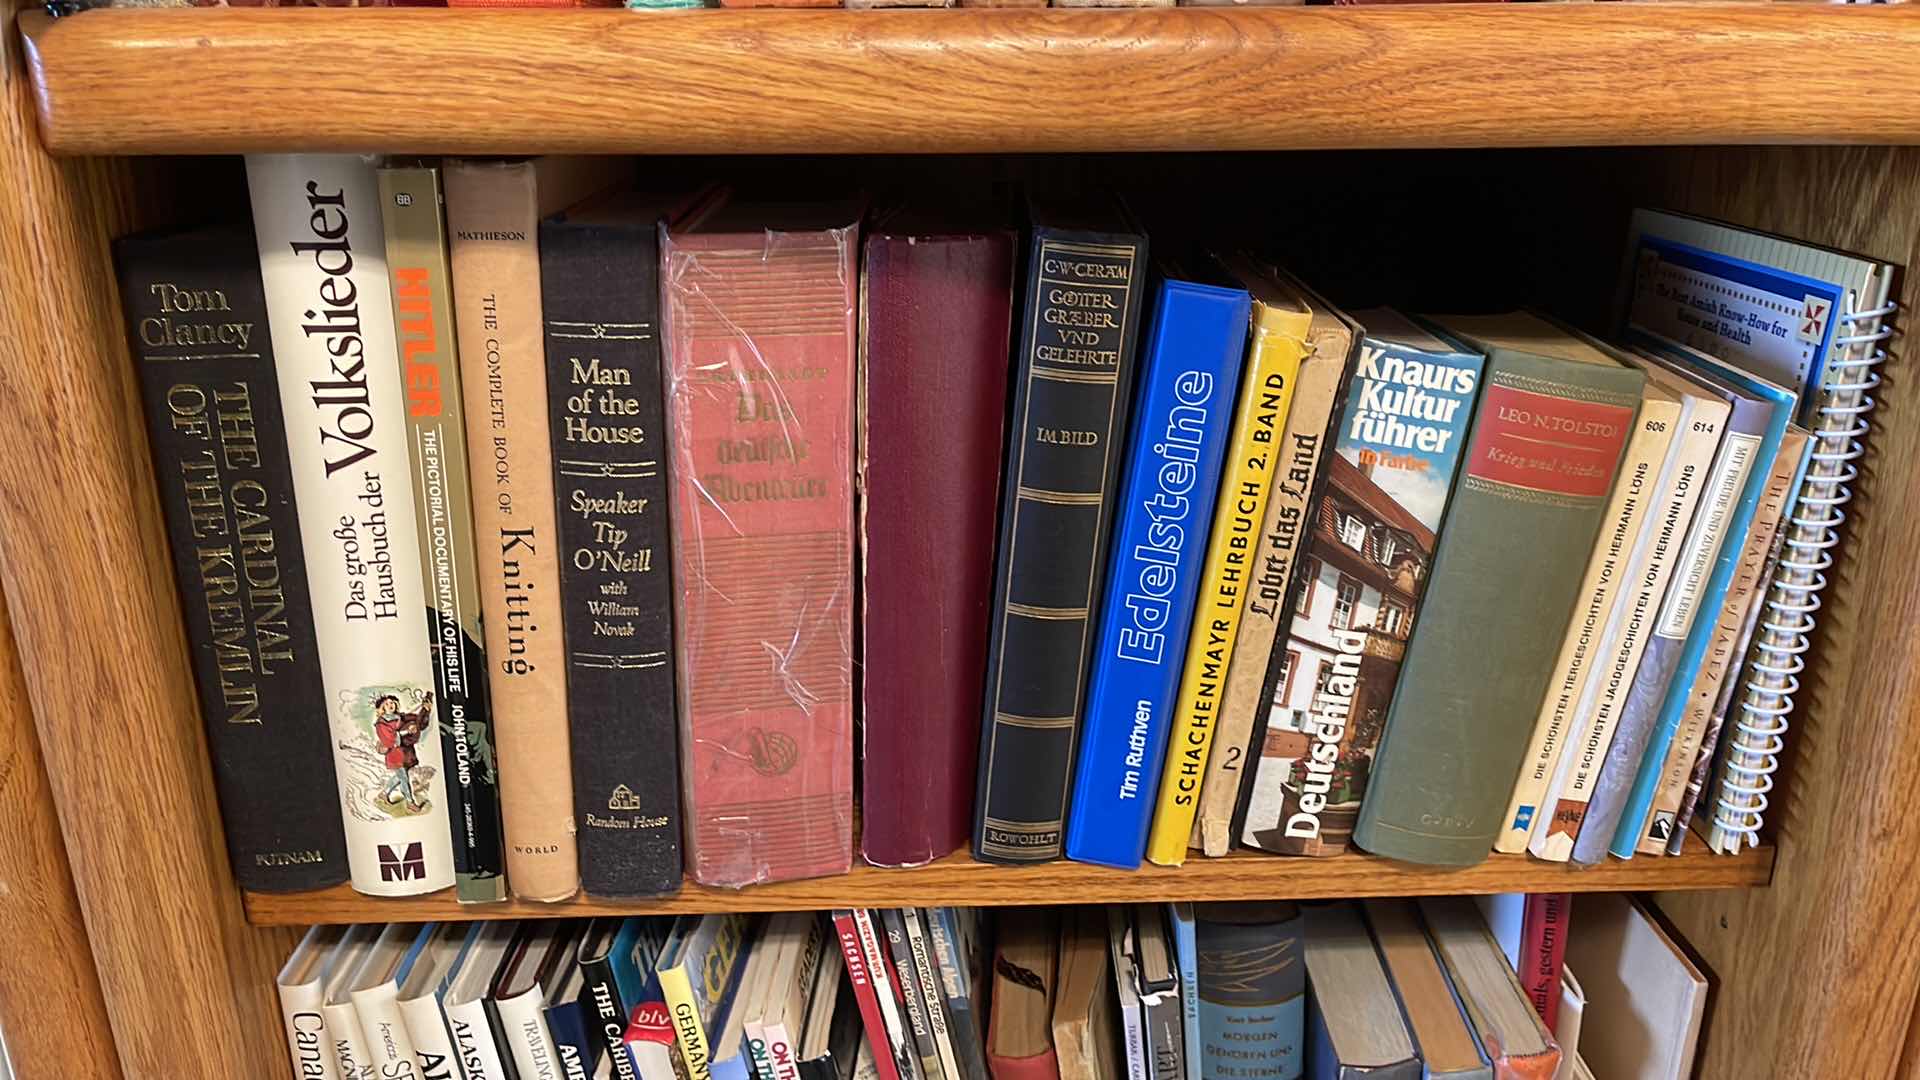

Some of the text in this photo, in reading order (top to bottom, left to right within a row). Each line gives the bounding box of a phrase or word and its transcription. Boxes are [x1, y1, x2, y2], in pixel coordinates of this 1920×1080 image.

[457, 232, 525, 241] MATHIESON
[151, 283, 231, 313] Tom
[140, 316, 253, 349] Clancy
[290, 180, 377, 479] Volkslieder
[1057, 329, 1100, 346] VND
[1718, 303, 1772, 333] Know-How
[1771, 321, 1788, 339] for
[1719, 323, 1752, 345] Health
[395, 267, 443, 418] HITLER
[1036, 345, 1118, 365] GELEHRTE
[570, 358, 631, 385] Man
[1356, 346, 1476, 394] Knaurs
[482, 294, 512, 515] THE COMPLETE BOOK OF
[568, 389, 640, 415] of the
[1358, 379, 1461, 423] Kultur
[1498, 406, 1531, 424] LEO
[1534, 414, 1550, 430] N.
[564, 417, 644, 443] House
[1036, 427, 1098, 446] IM BILD
[1350, 411, 1452, 453] führer
[1693, 421, 1713, 433] 614
[1279, 431, 1319, 502] Land
[1359, 448, 1376, 465] in
[1488, 447, 1525, 468] Krieg
[1529, 456, 1558, 472] und
[570, 489, 648, 518] Speaker
[1117, 370, 1213, 665] Edelsteine
[213, 382, 294, 676] THE CARDINAL
[358, 471, 398, 620] Hausbuch der
[592, 521, 628, 550] Tip
[1268, 506, 1301, 550] das
[1672, 446, 1748, 630] MIT FREUDE UND ZUVERSICHT LEBEN
[167, 384, 263, 727] OF THE KREMLIN
[332, 514, 369, 622] Das große
[424, 430, 461, 692] THE PICTORIAL DOCUMENTARY OF HIS LIFE
[574, 548, 651, 572] O'Neill
[600, 581, 628, 595] with
[1176, 373, 1284, 806] SCHACHENMAYR LEHRBUCH 2. BAND
[1704, 472, 1791, 682] THE PRAYER of JABEZ
[501, 526, 536, 677] Knitting
[587, 601, 640, 617] William
[593, 621, 635, 636] Novak
[1534, 762, 1546, 780] DIE
[1563, 587, 1606, 692] TIERGESCHICHTEN
[1600, 559, 1615, 586] VON
[1609, 498, 1636, 559] HERMANN
[1574, 773, 1588, 790] DIE
[1605, 590, 1651, 702] JAGDGESCHICHTEN
[1643, 562, 1660, 588] VON
[1653, 501, 1682, 561] HERMANN
[451, 704, 471, 784] JOHN TOLAND
[1120, 699, 1152, 800] Tim Ruthven
[1284, 630, 1368, 840] Deutschland
[1670, 708, 1704, 788] WILKINSON
[1223, 747, 1241, 770] 2
[586, 813, 669, 829] Random House
[990, 831, 1057, 844] ROWOHLT
[255, 849, 323, 866] PUTNAM
[515, 845, 559, 854] WORLD
[842, 932, 867, 985] SACHSEN
[911, 935, 936, 1001] Romantische
[1540, 926, 1556, 979] gestern
[592, 982, 616, 1019] THE
[888, 929, 928, 1037] 29 Weserbergland
[638, 1009, 671, 1025] blv
[292, 1012, 325, 1080] Cana
[750, 1038, 769, 1062] ON
[771, 1041, 792, 1066] ON
